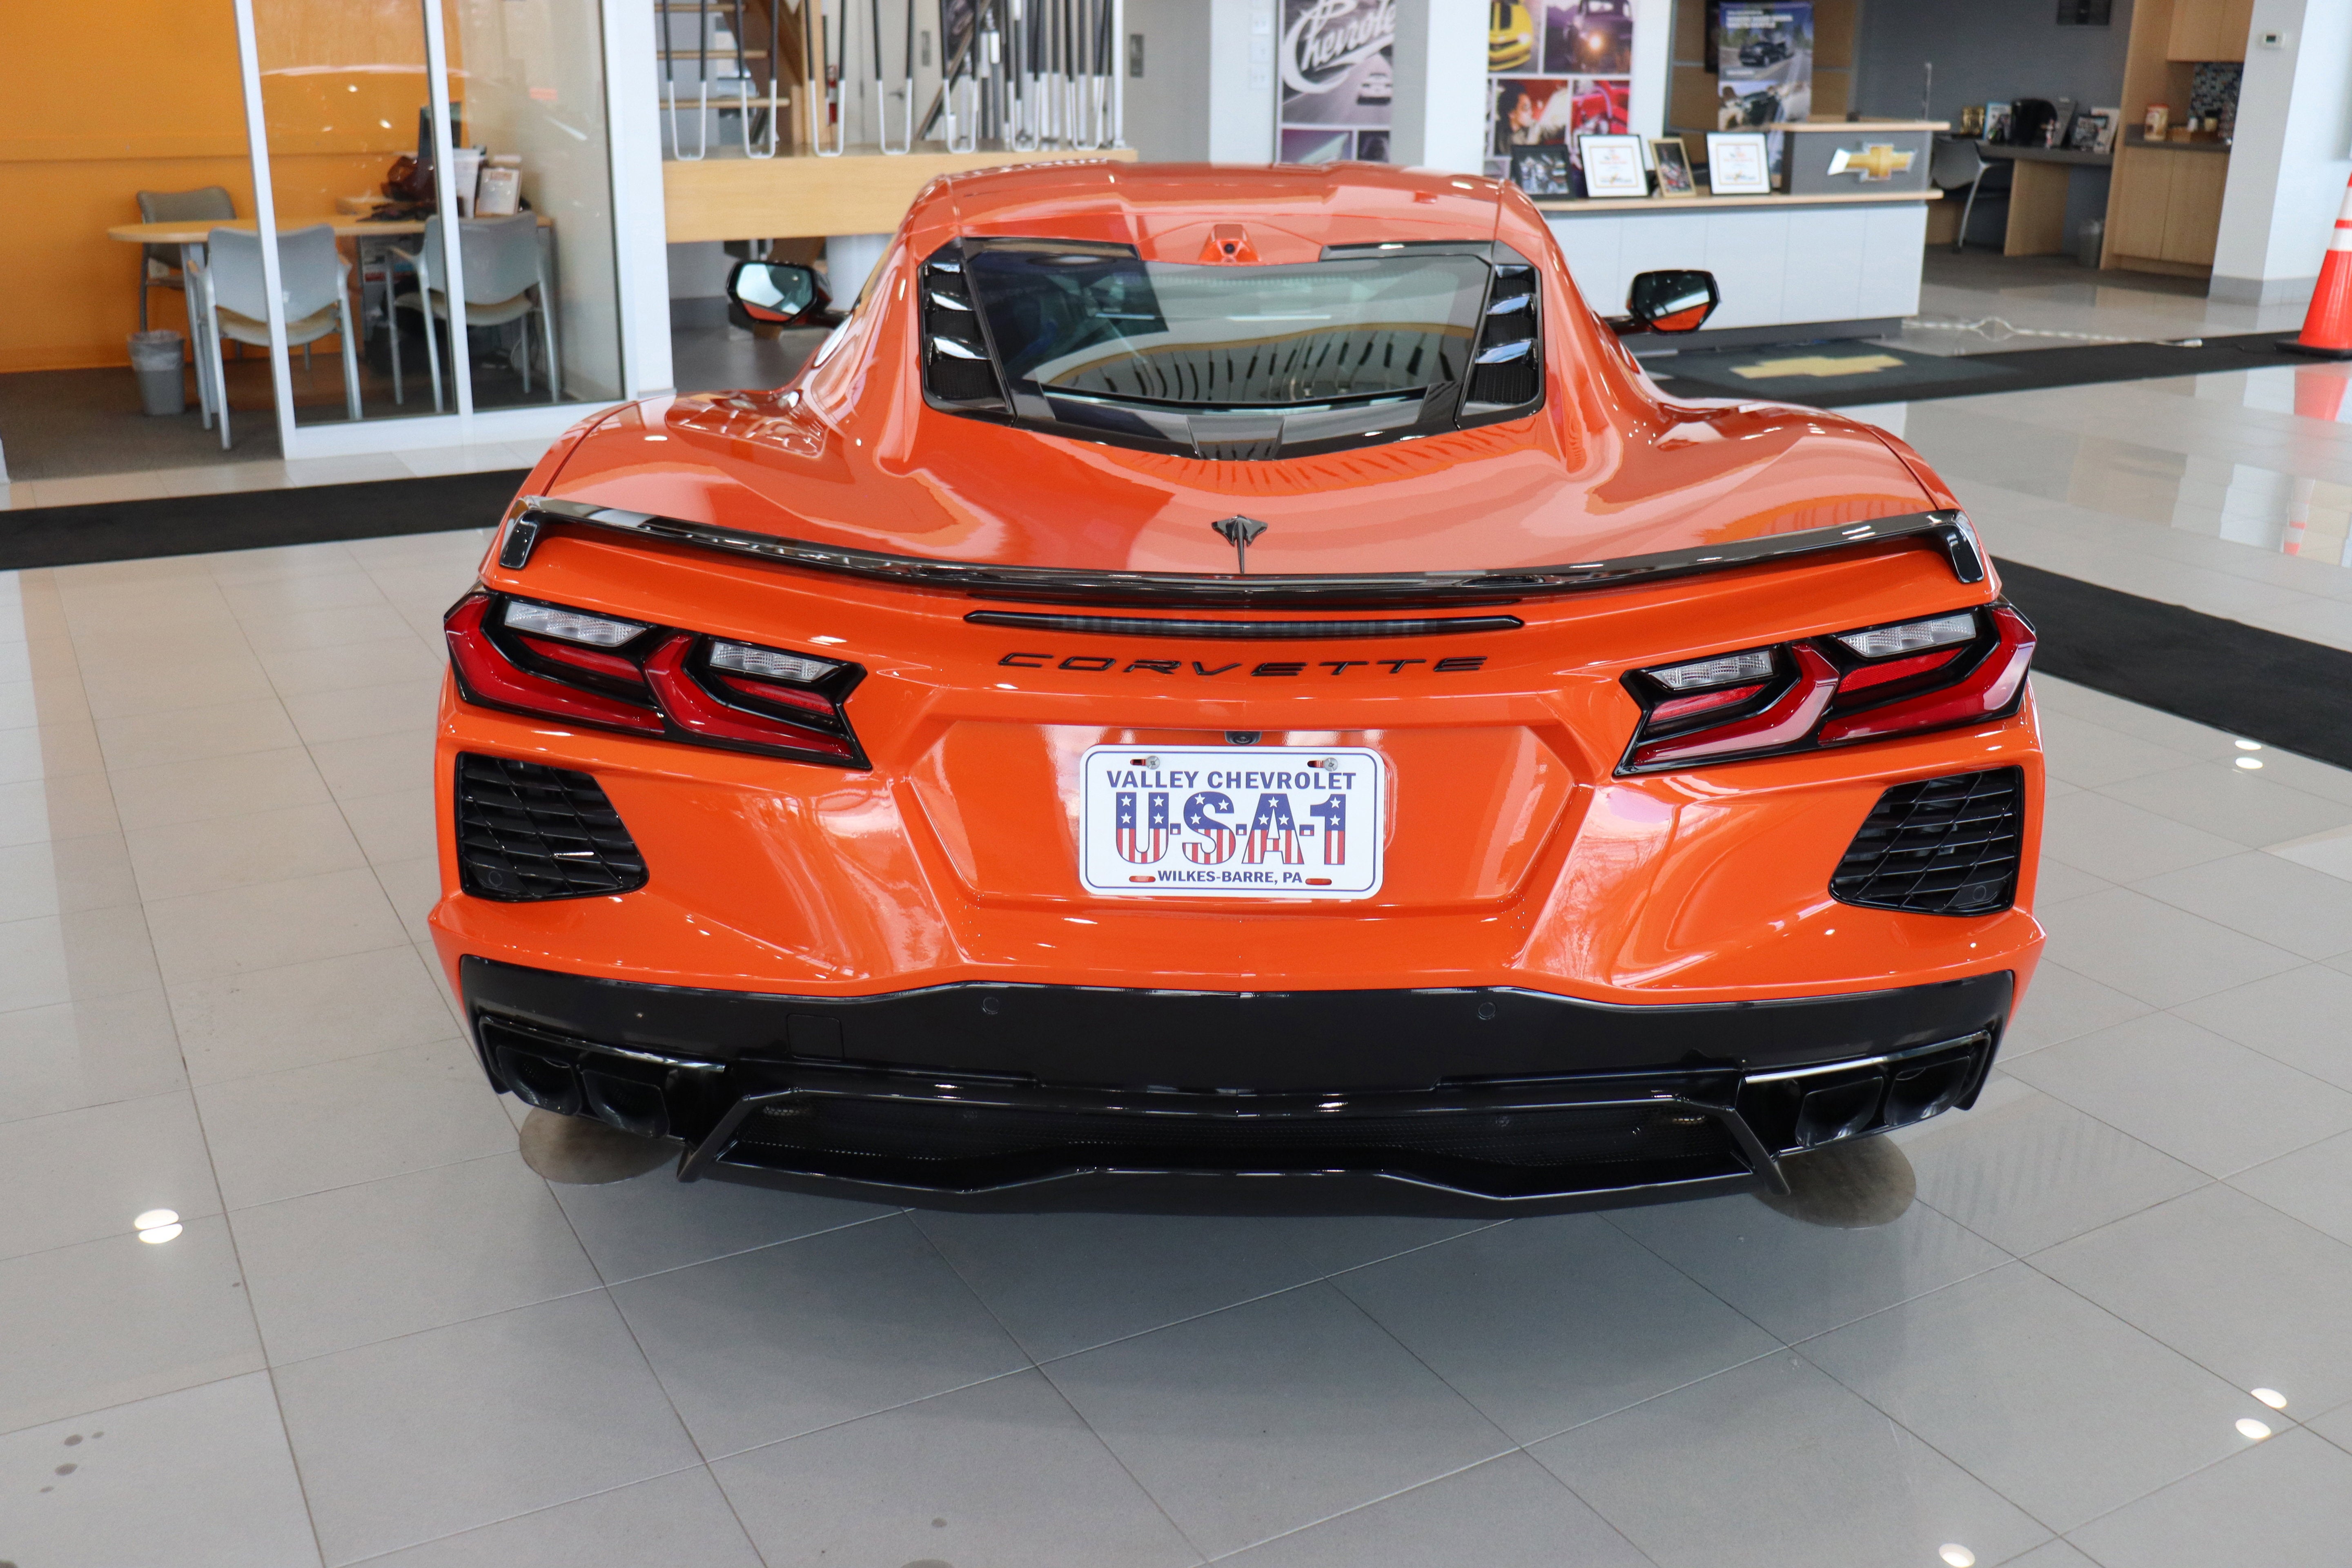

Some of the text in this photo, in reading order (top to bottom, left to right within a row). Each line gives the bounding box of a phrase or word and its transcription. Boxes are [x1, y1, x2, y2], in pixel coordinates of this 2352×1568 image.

[1282, 0, 1396, 94] Chevrole
[998, 652, 1488, 677] CORVETTE
[1107, 771, 1356, 790] VALLEY CHEVROLET
[1157, 870, 1303, 885] WILKES-BARRE, PA
